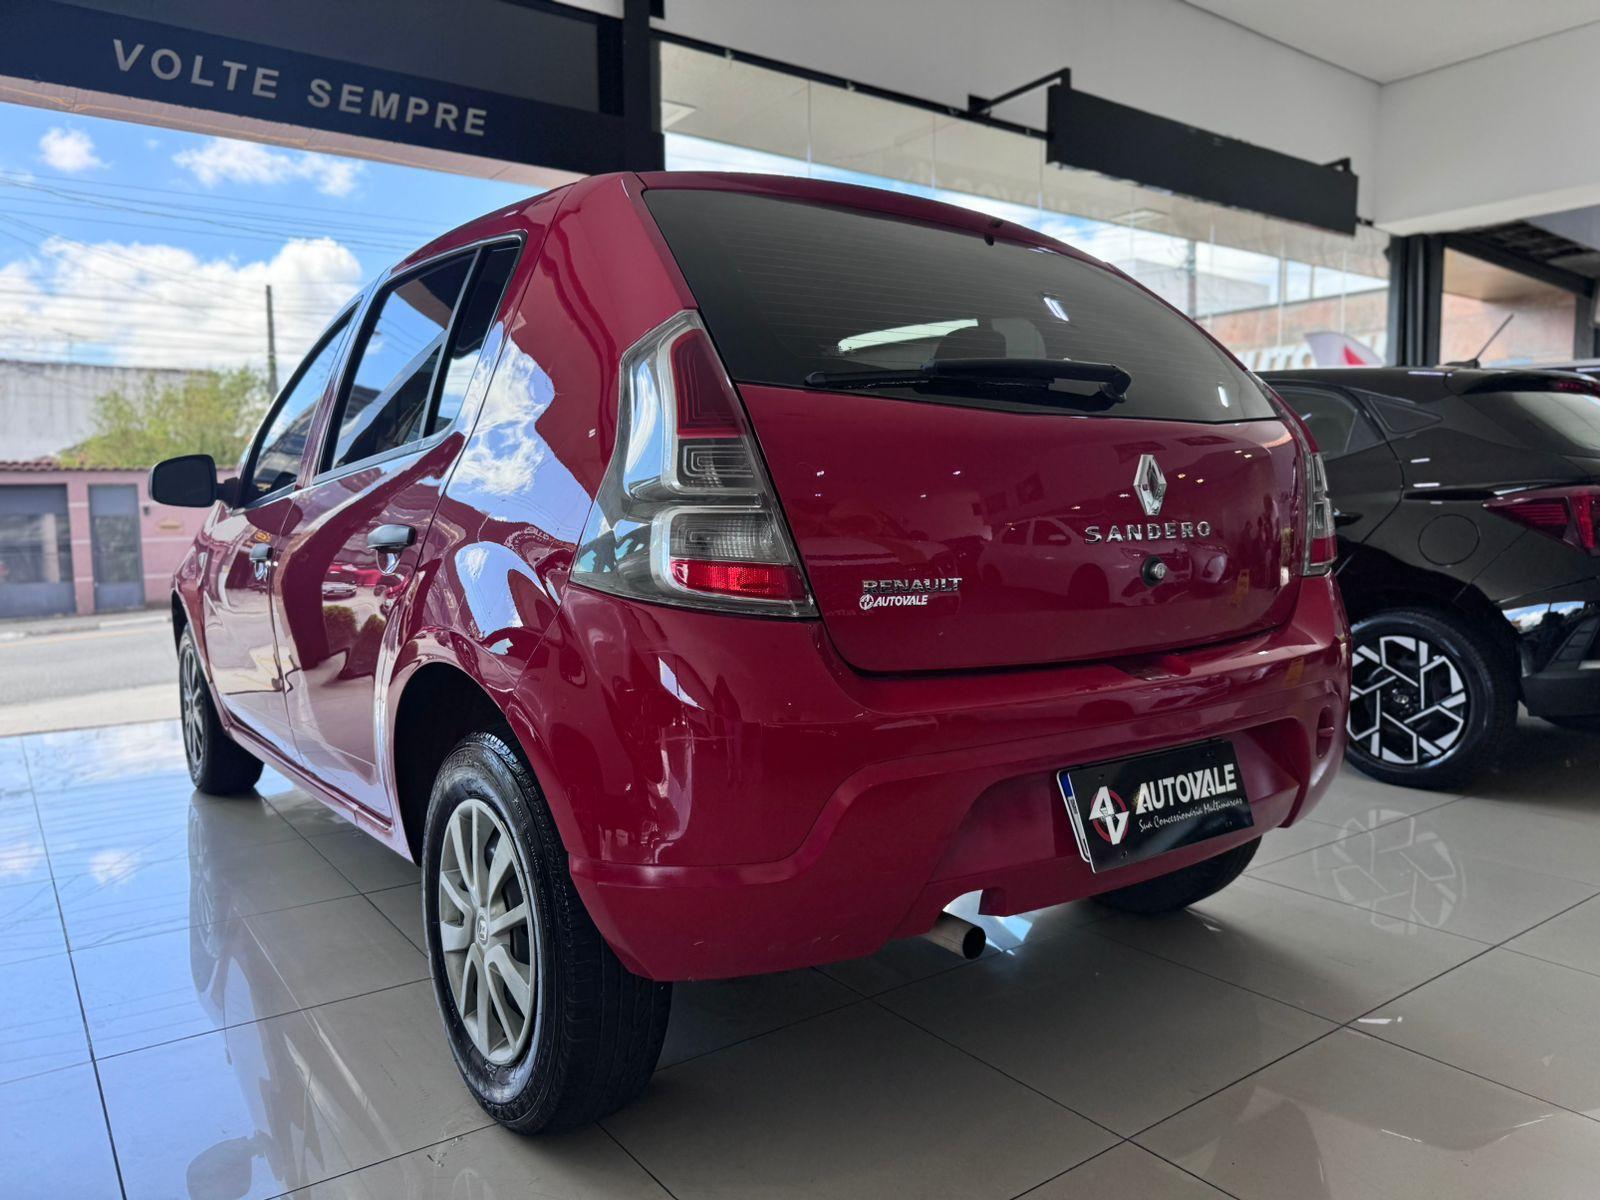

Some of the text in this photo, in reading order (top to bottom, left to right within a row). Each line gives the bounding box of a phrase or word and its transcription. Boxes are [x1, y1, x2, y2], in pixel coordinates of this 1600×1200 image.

[112, 38, 488, 137] VOLTE SEMPRE
[1084, 520, 1212, 545] SANDERO
[862, 577, 963, 594] RENAULT
[873, 594, 929, 608] AUTOVALE
[1135, 763, 1238, 815] AUTOVALE
[1138, 818, 1153, 833] Sua
[1203, 797, 1243, 815] Multimarcas
